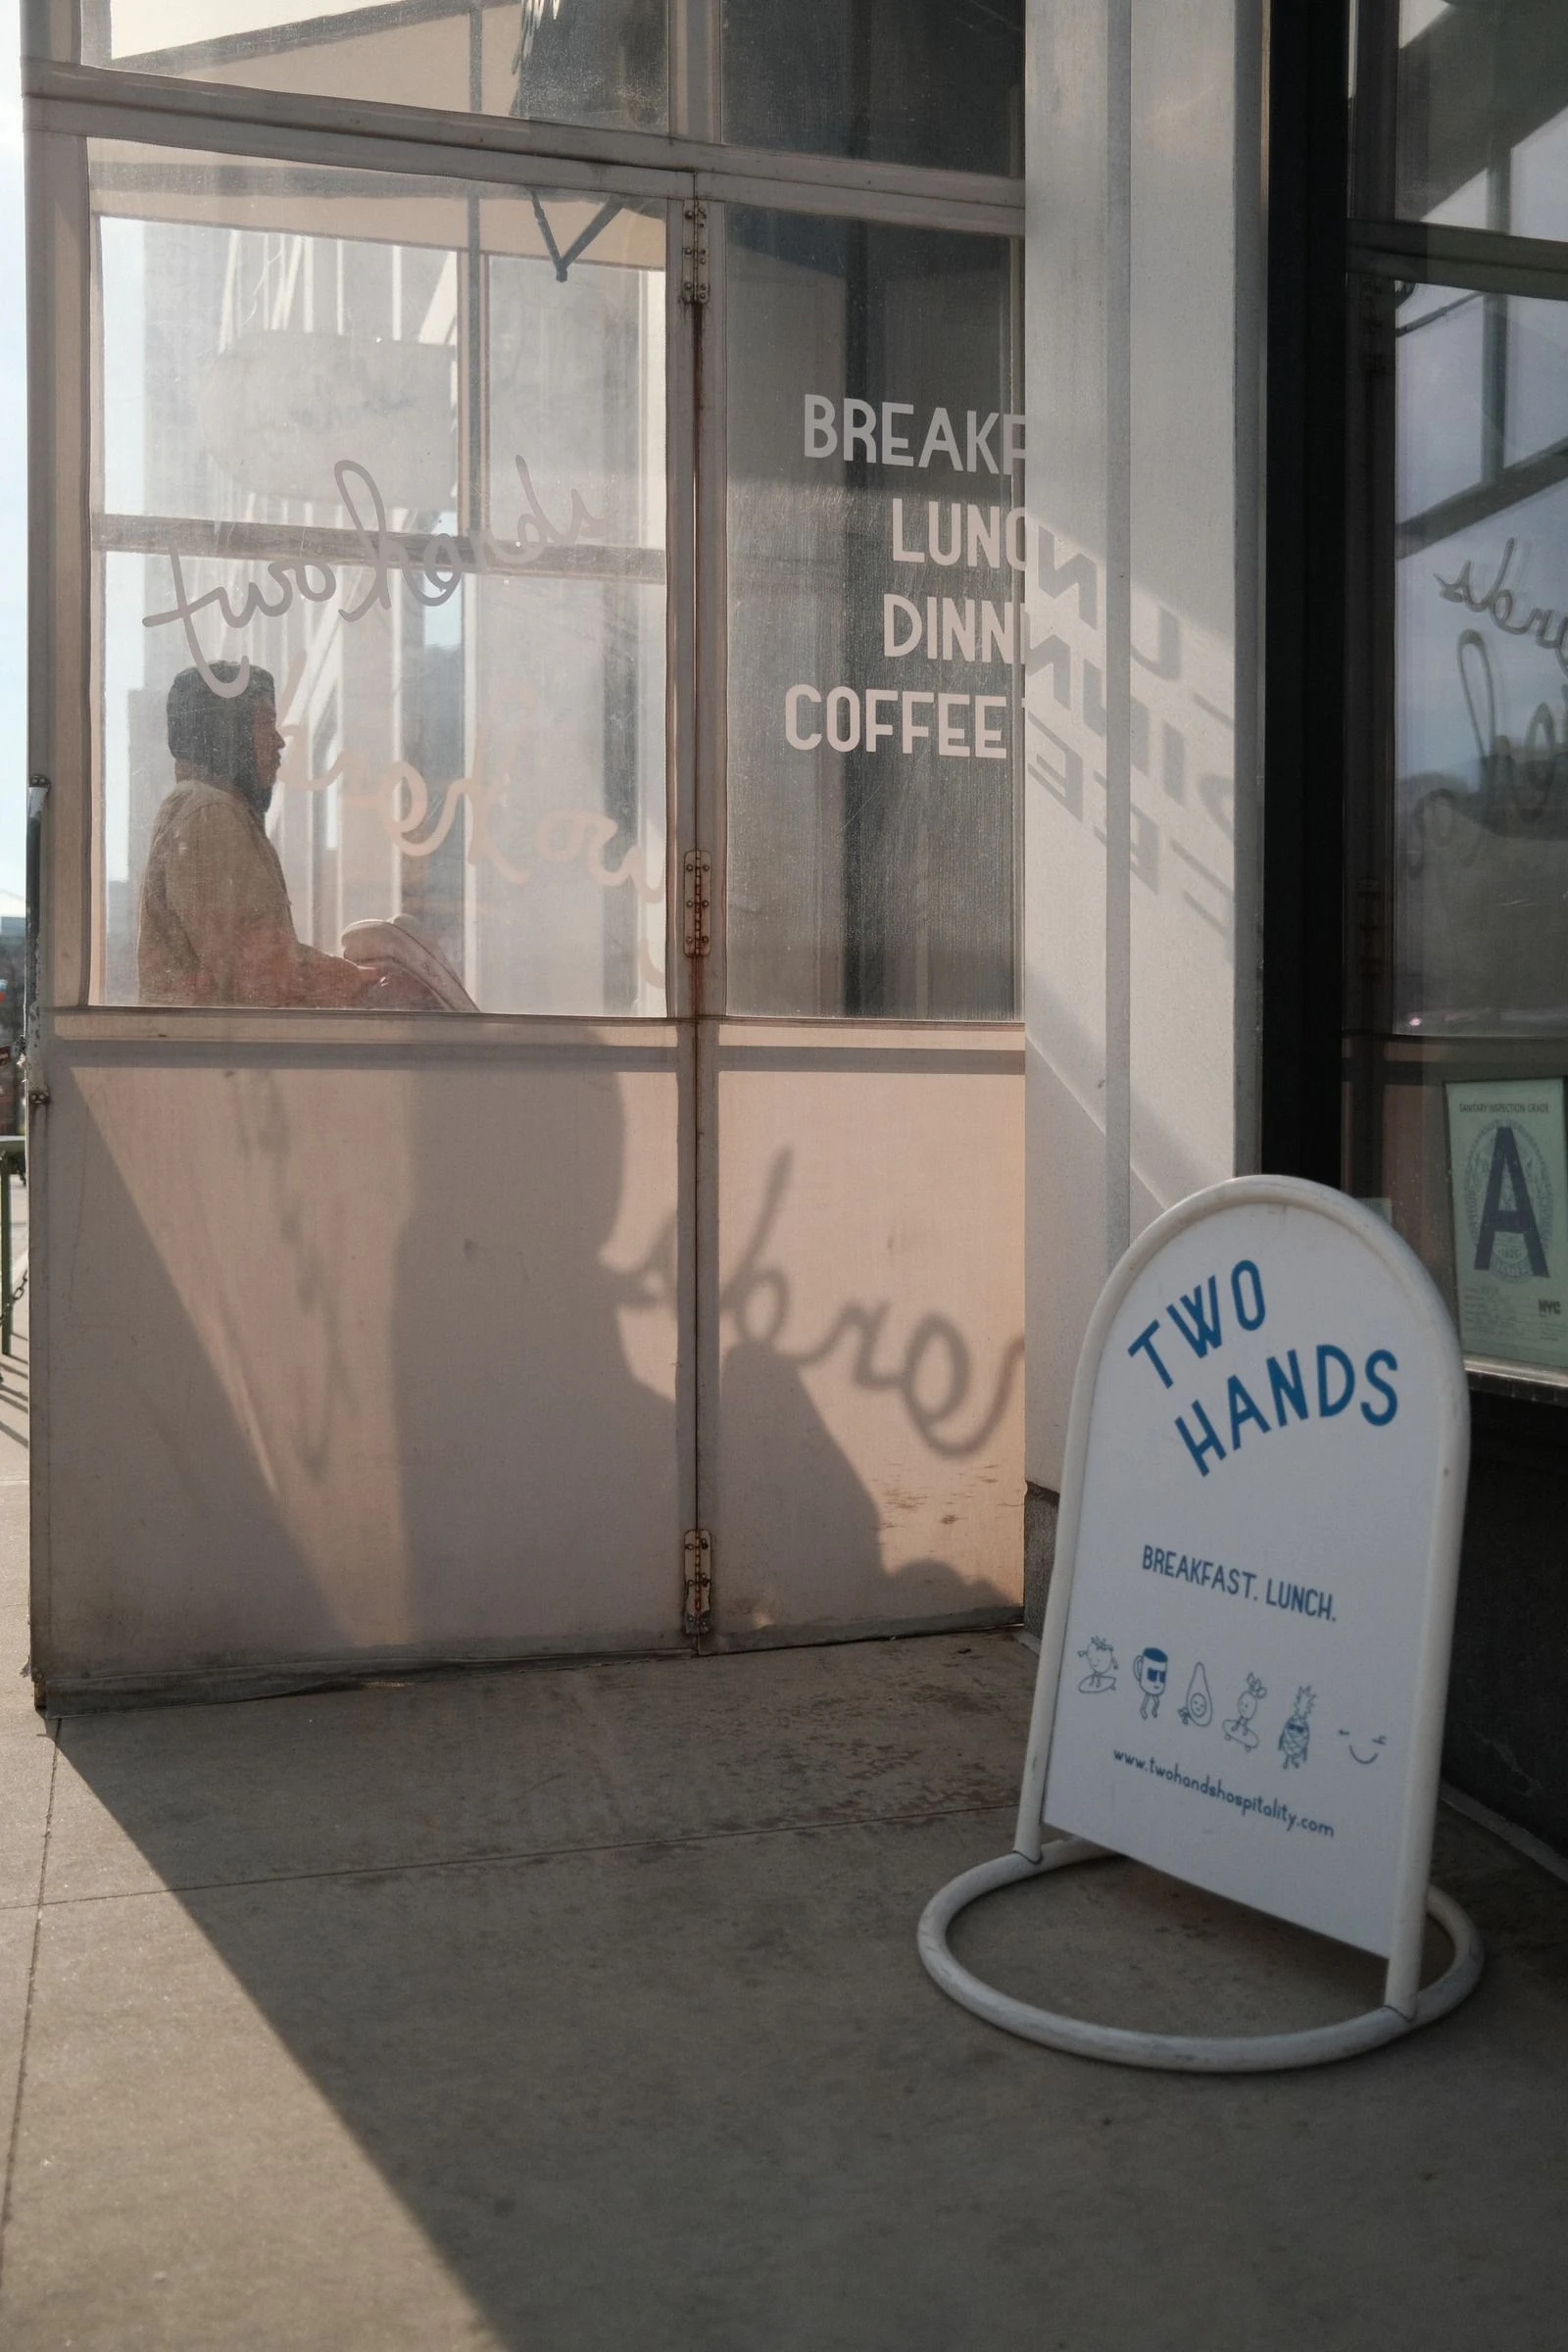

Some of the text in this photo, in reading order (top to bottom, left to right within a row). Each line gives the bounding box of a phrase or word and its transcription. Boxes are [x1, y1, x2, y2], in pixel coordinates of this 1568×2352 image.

[884, 593, 1025, 664] DINN
[786, 684, 1006, 760] COFFEE
[1474, 1126, 1550, 1279] A
[1127, 1259, 1266, 1390] TWO
[1173, 1344, 1398, 1478] HANDS
[1142, 1544, 1337, 1622] BREAKFAST. LUNCH.
[1113, 1748, 1335, 1838] www.twohandshospitality.com
